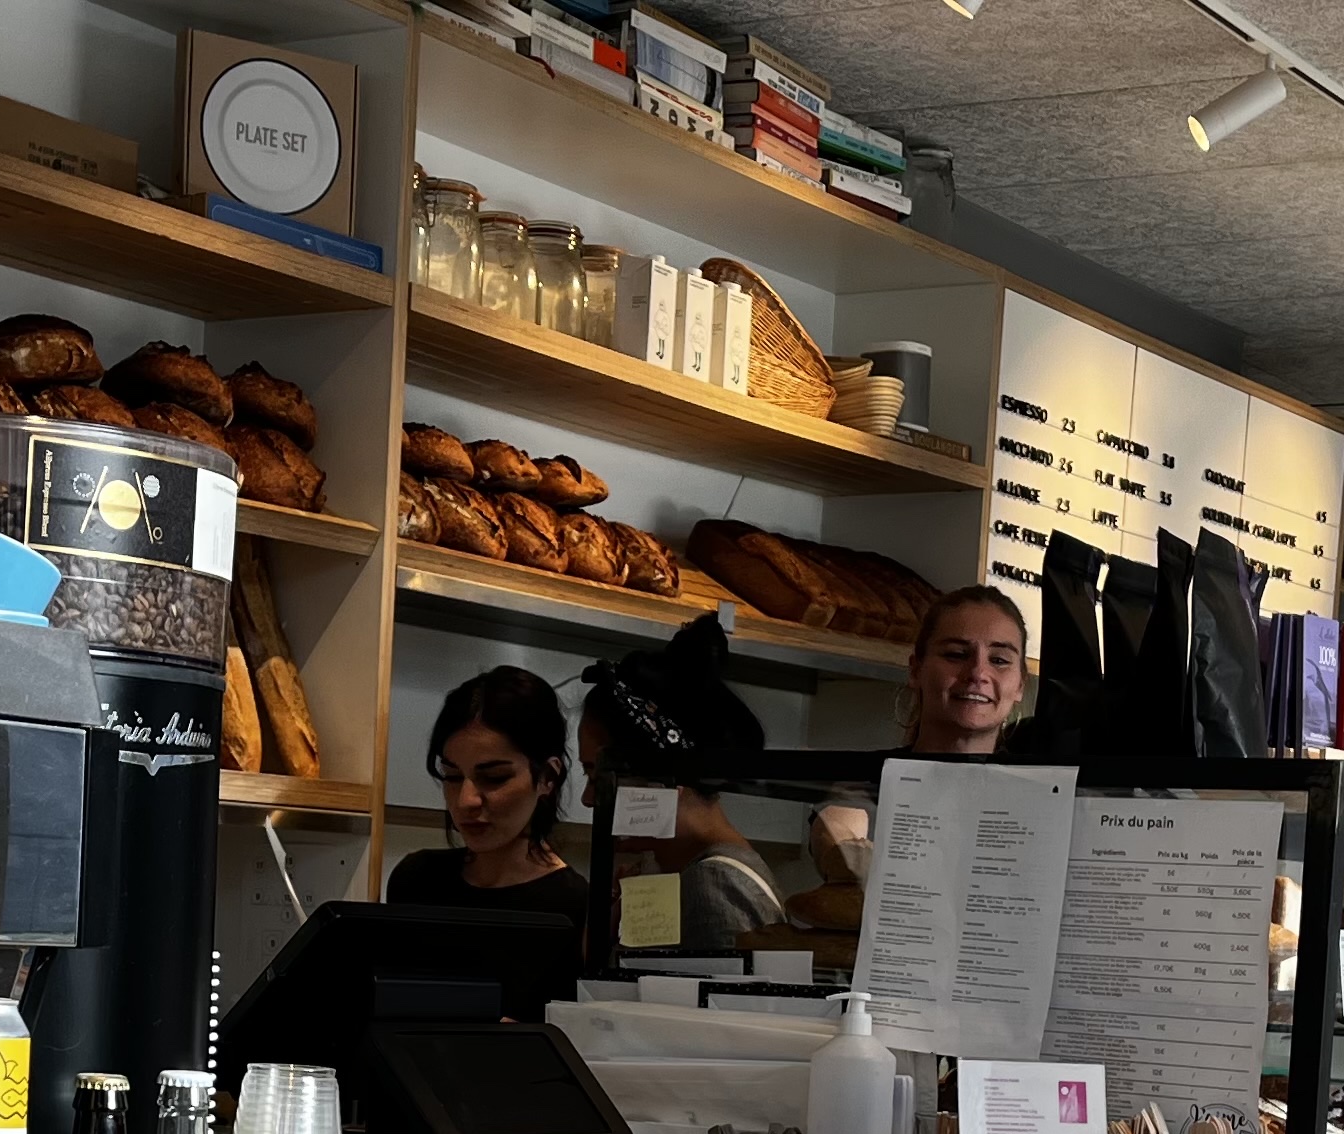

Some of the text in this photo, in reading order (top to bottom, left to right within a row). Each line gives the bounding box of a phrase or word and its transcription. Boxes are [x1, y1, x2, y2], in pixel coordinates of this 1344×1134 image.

[236, 121, 308, 154] PLATE SET
[1001, 394, 1048, 424] ESPRESSO
[998, 435, 1053, 467] MACCHIATO
[1096, 429, 1149, 460] CAPPUCCINO
[1094, 469, 1115, 487] FLAT
[1119, 476, 1147, 500] WHITE
[1092, 508, 1119, 529] LATTE
[1318, 645, 1337, 667] 100%
[156, 711, 212, 749] Arduino
[1100, 814, 1174, 830] Prix du pain
